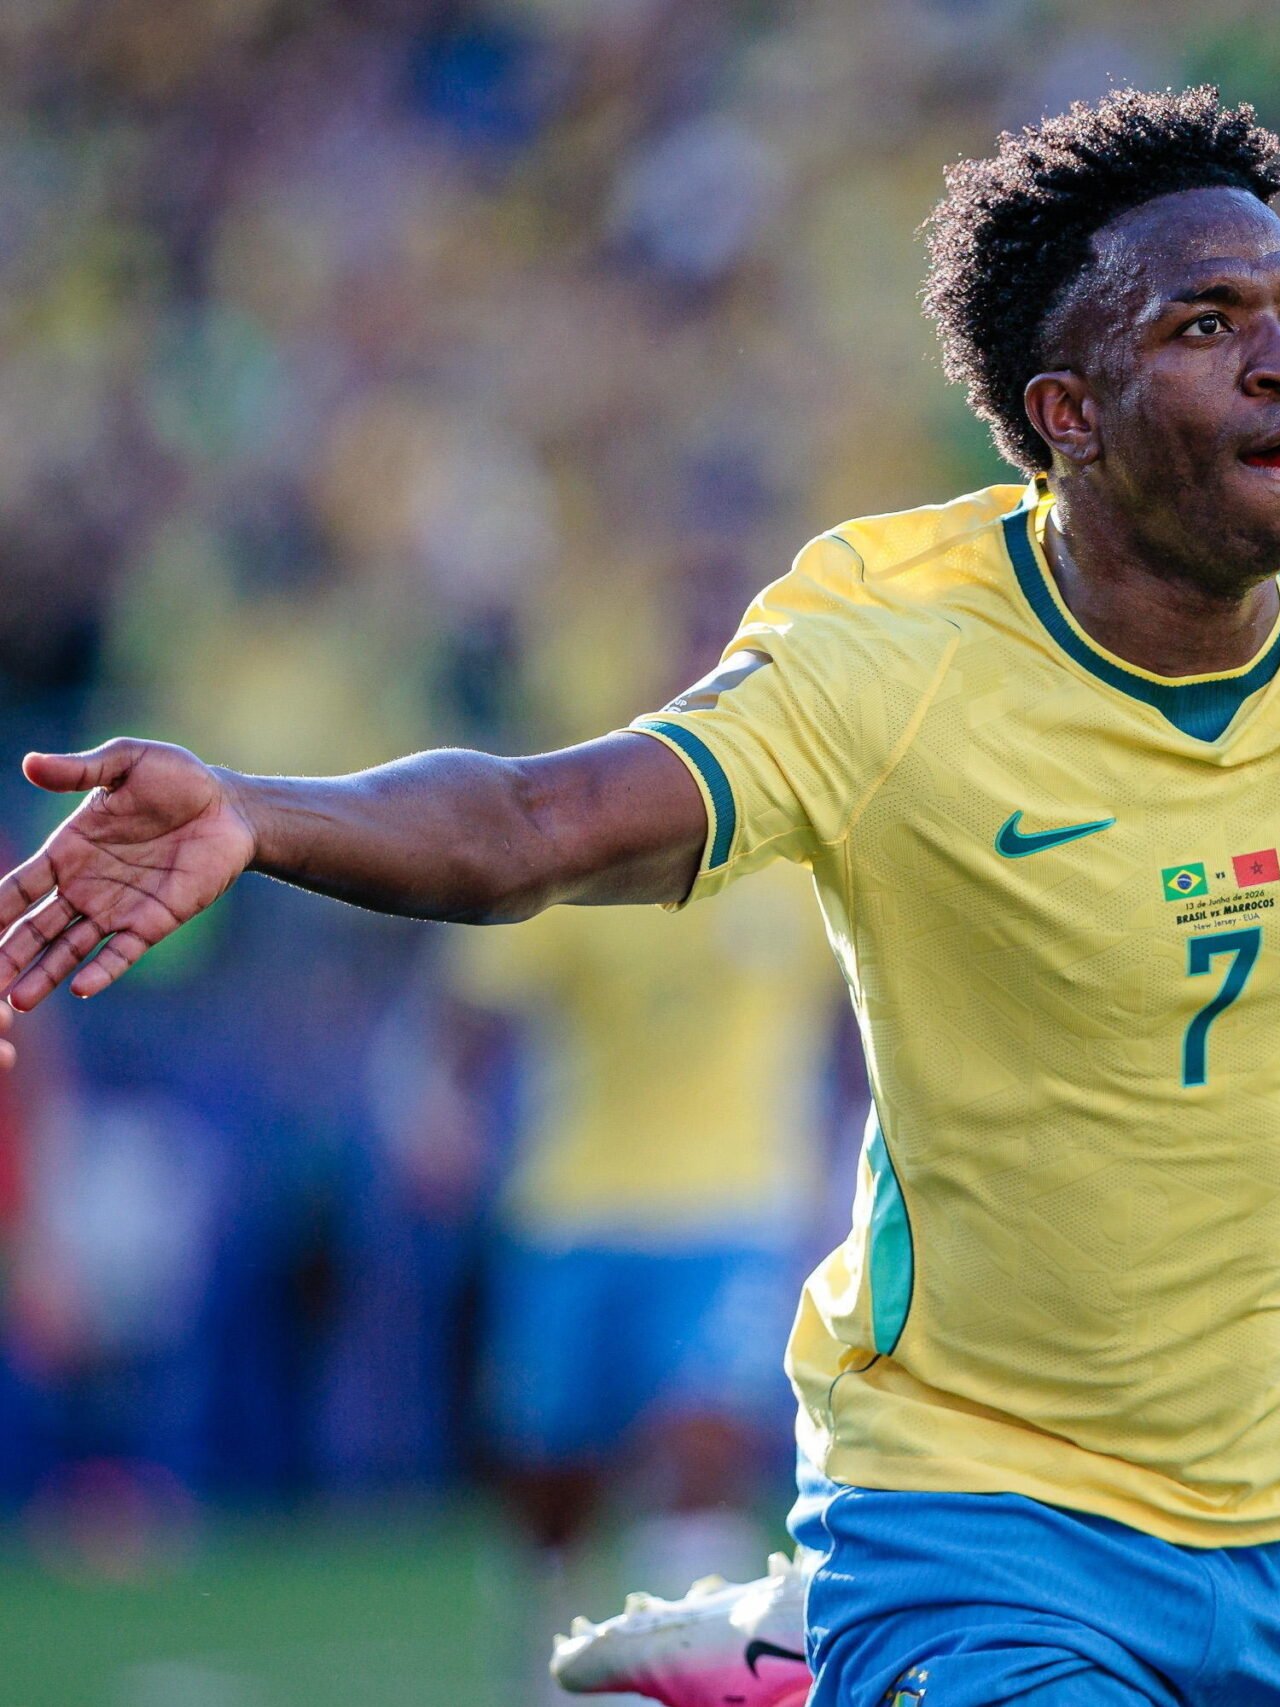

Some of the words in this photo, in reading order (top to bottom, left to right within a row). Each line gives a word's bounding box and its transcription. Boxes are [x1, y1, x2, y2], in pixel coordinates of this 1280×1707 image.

[1215, 871, 1226, 879] vs
[1185, 902, 1195, 910] 13
[1197, 900, 1206, 909] de
[1232, 893, 1243, 901] de
[1244, 889, 1265, 899] 2026
[1176, 911, 1207, 925] BRASIL
[1210, 910, 1220, 918] vs
[1223, 897, 1275, 915] MARROCOS
[1193, 923, 1212, 931] New
[1213, 918, 1237, 928] Jersey
[1243, 912, 1261, 922] EUA
[1182, 926, 1263, 1087] 7
